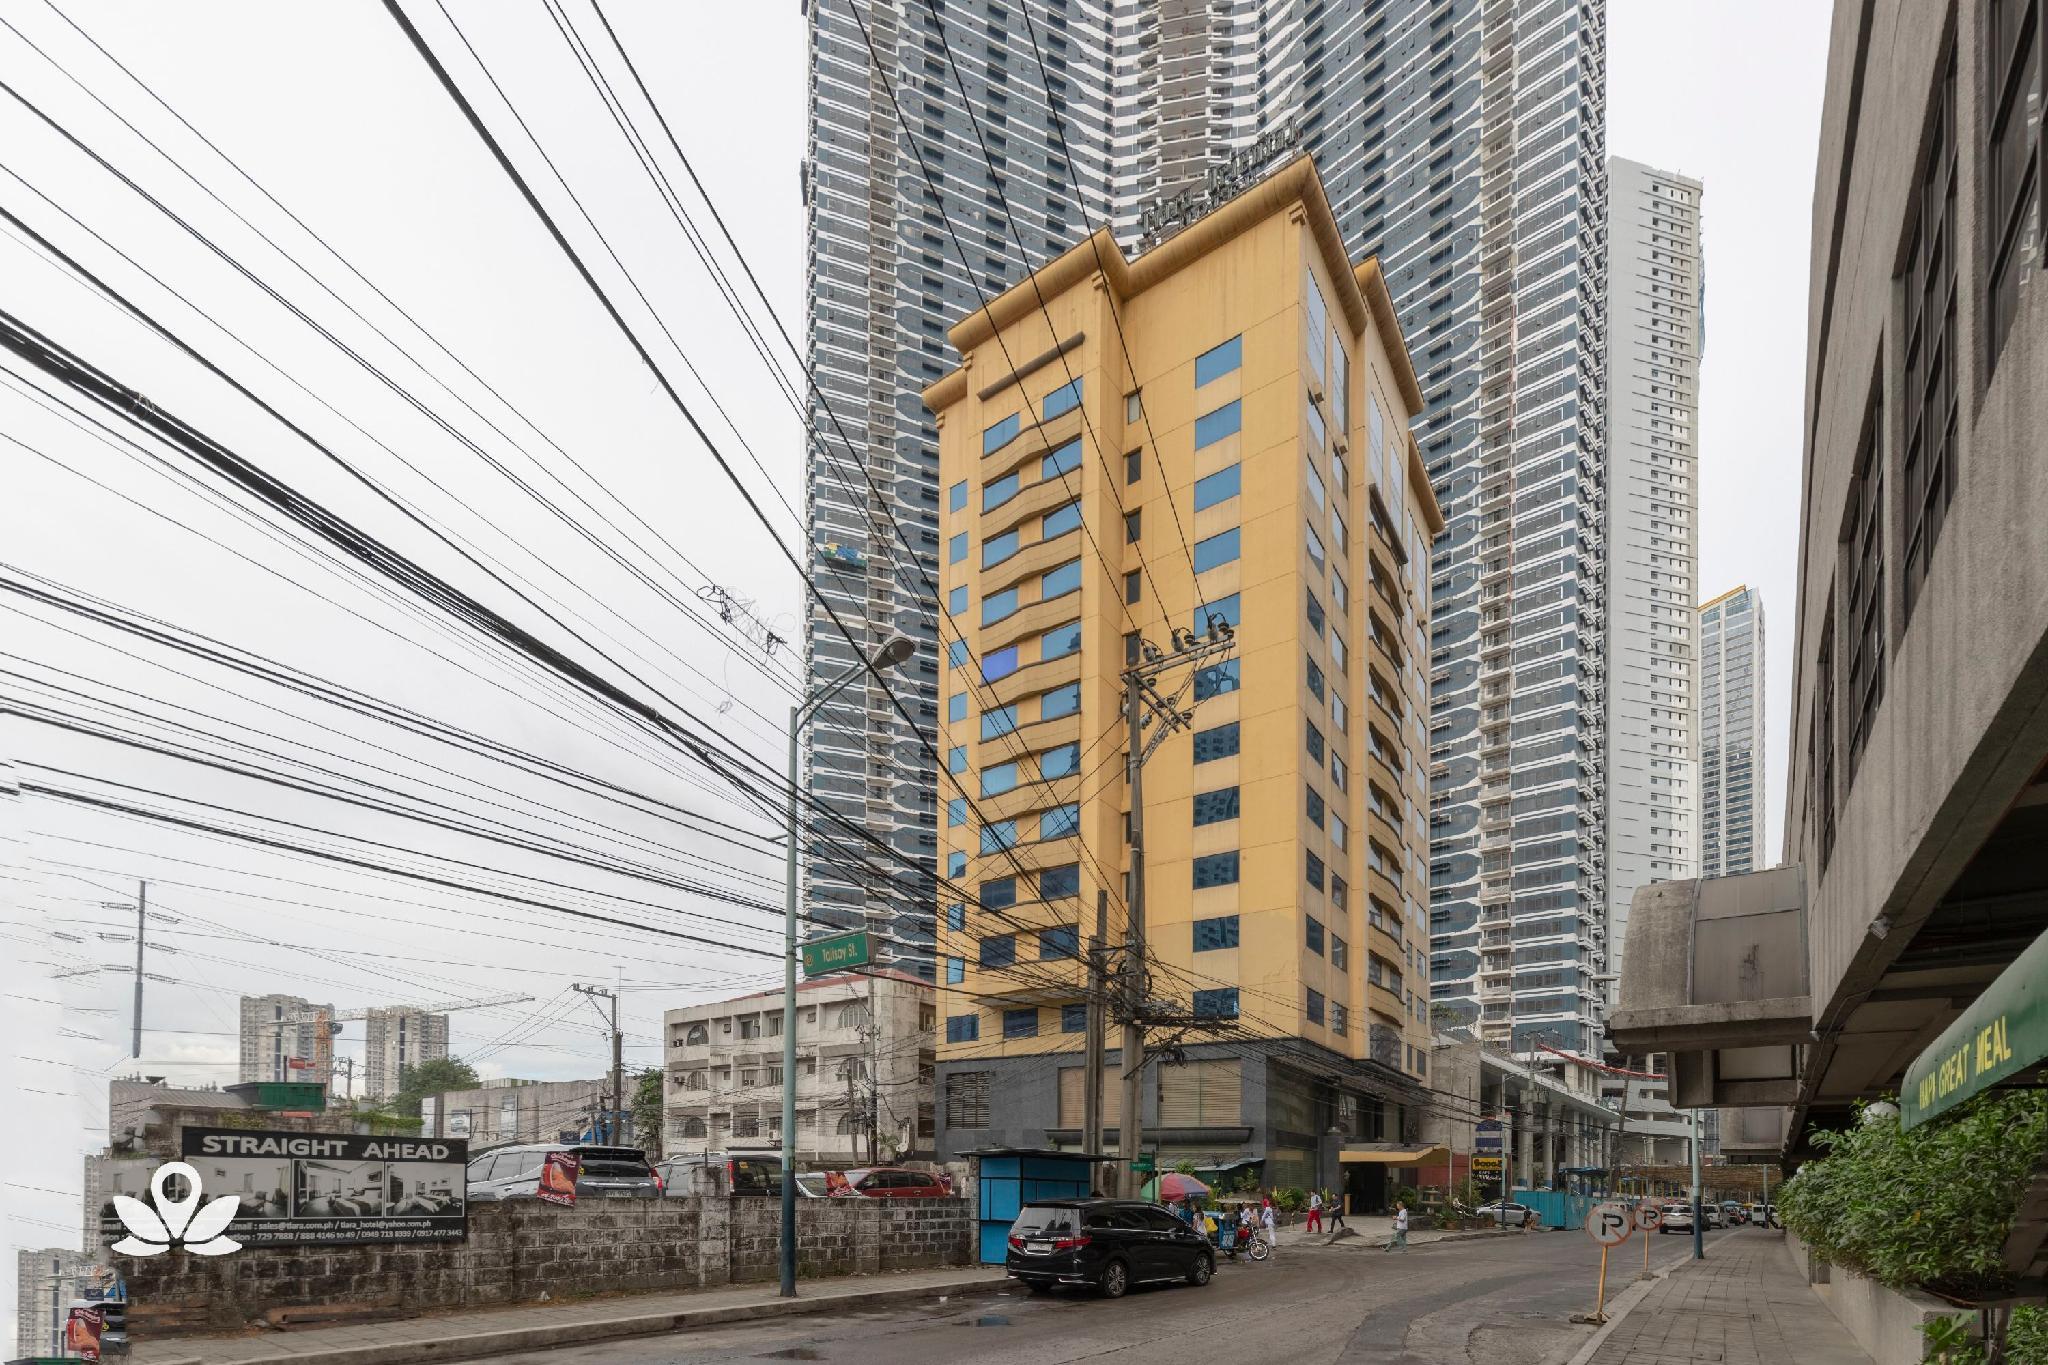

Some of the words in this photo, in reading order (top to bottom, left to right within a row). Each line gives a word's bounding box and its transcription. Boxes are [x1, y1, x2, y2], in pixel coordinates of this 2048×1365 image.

[848, 943, 858, 957] St.
[1938, 1042, 1970, 1098] GREAT
[1975, 1015, 2012, 1077] MEAL
[202, 1135, 349, 1157] STRAIGHT
[361, 1141, 450, 1160] AHEAD
[229, 1222, 253, 1231] Email
